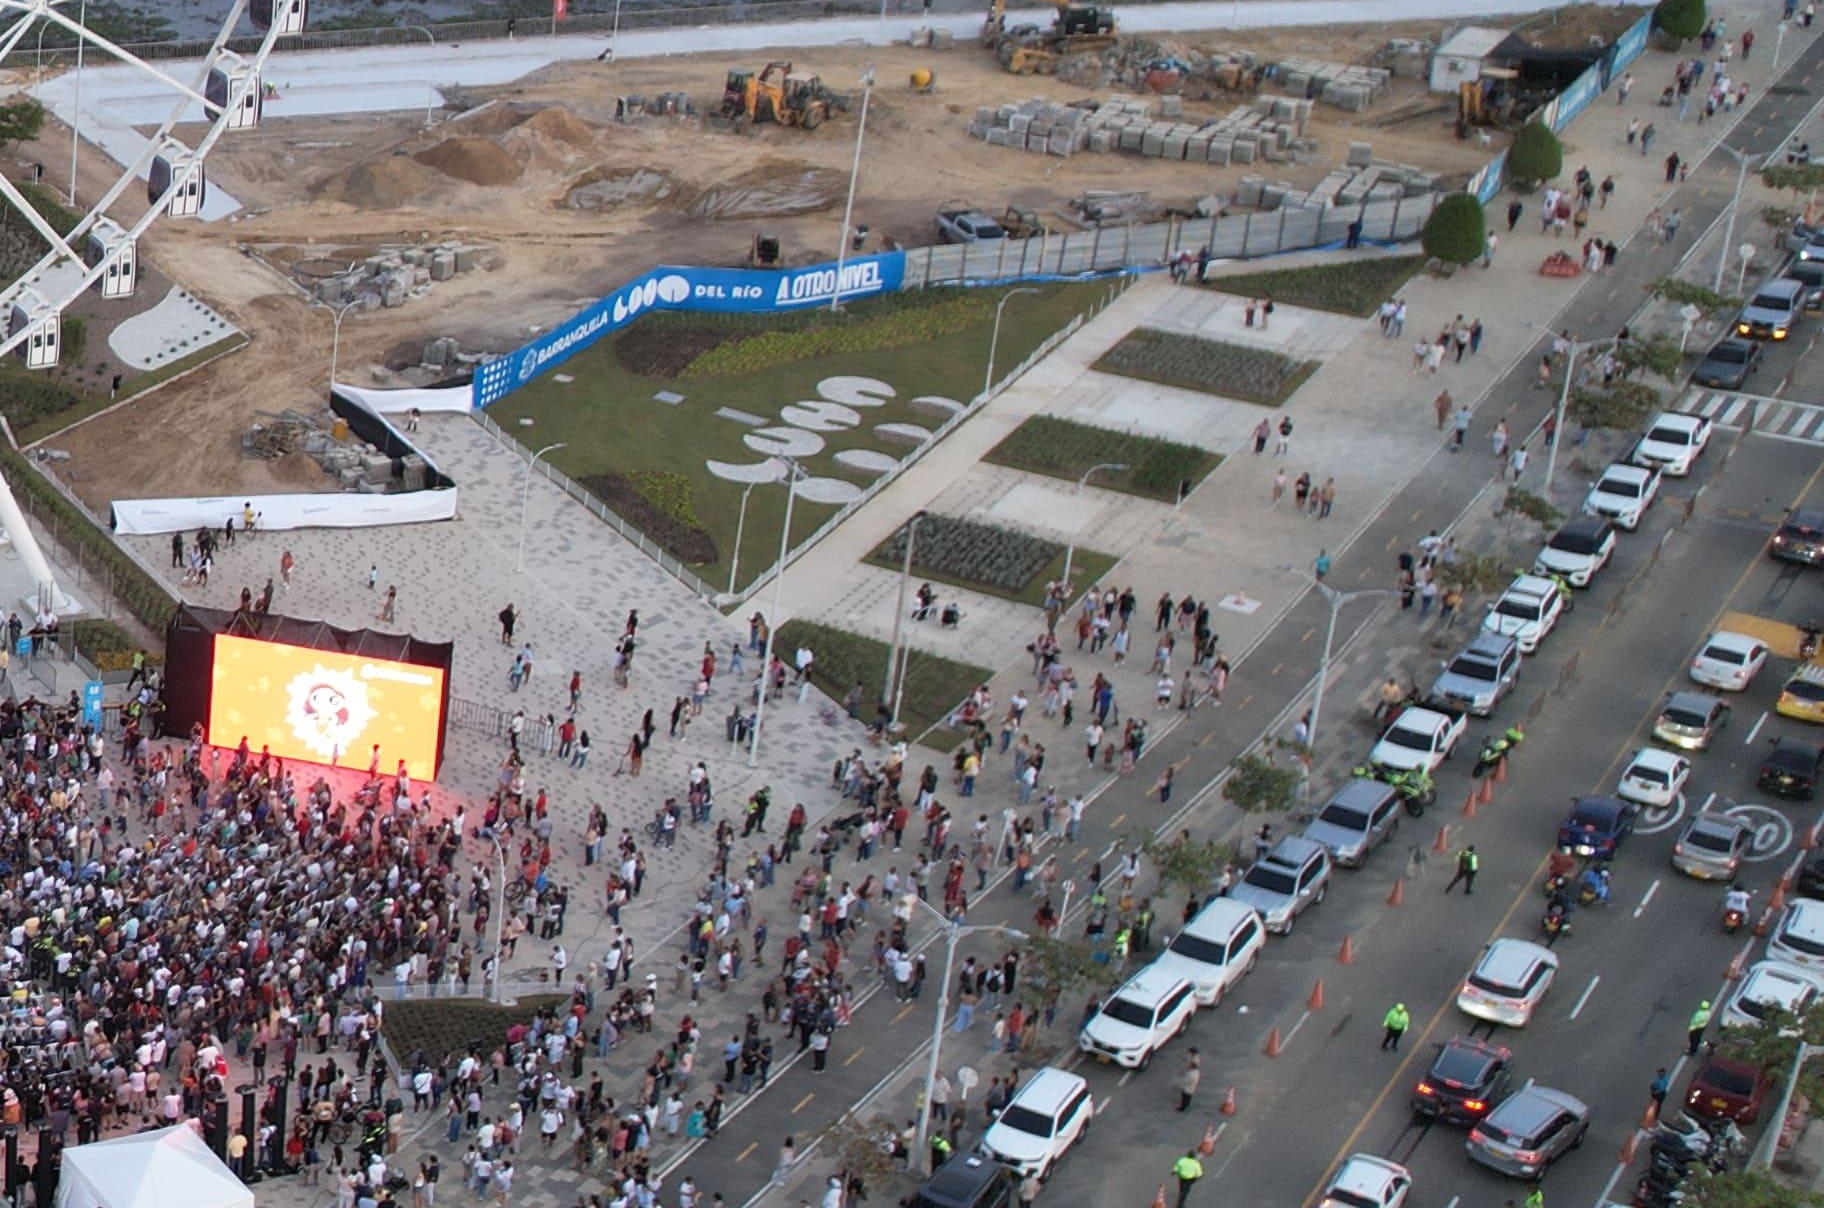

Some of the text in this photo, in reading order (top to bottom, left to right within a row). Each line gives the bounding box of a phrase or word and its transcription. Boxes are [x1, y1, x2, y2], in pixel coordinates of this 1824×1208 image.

[776, 261, 882, 300] A OTRO NIVEL
[537, 310, 608, 364] BARRANQUILLA
[695, 285, 726, 298] DEL
[732, 285, 763, 298] RÍO
